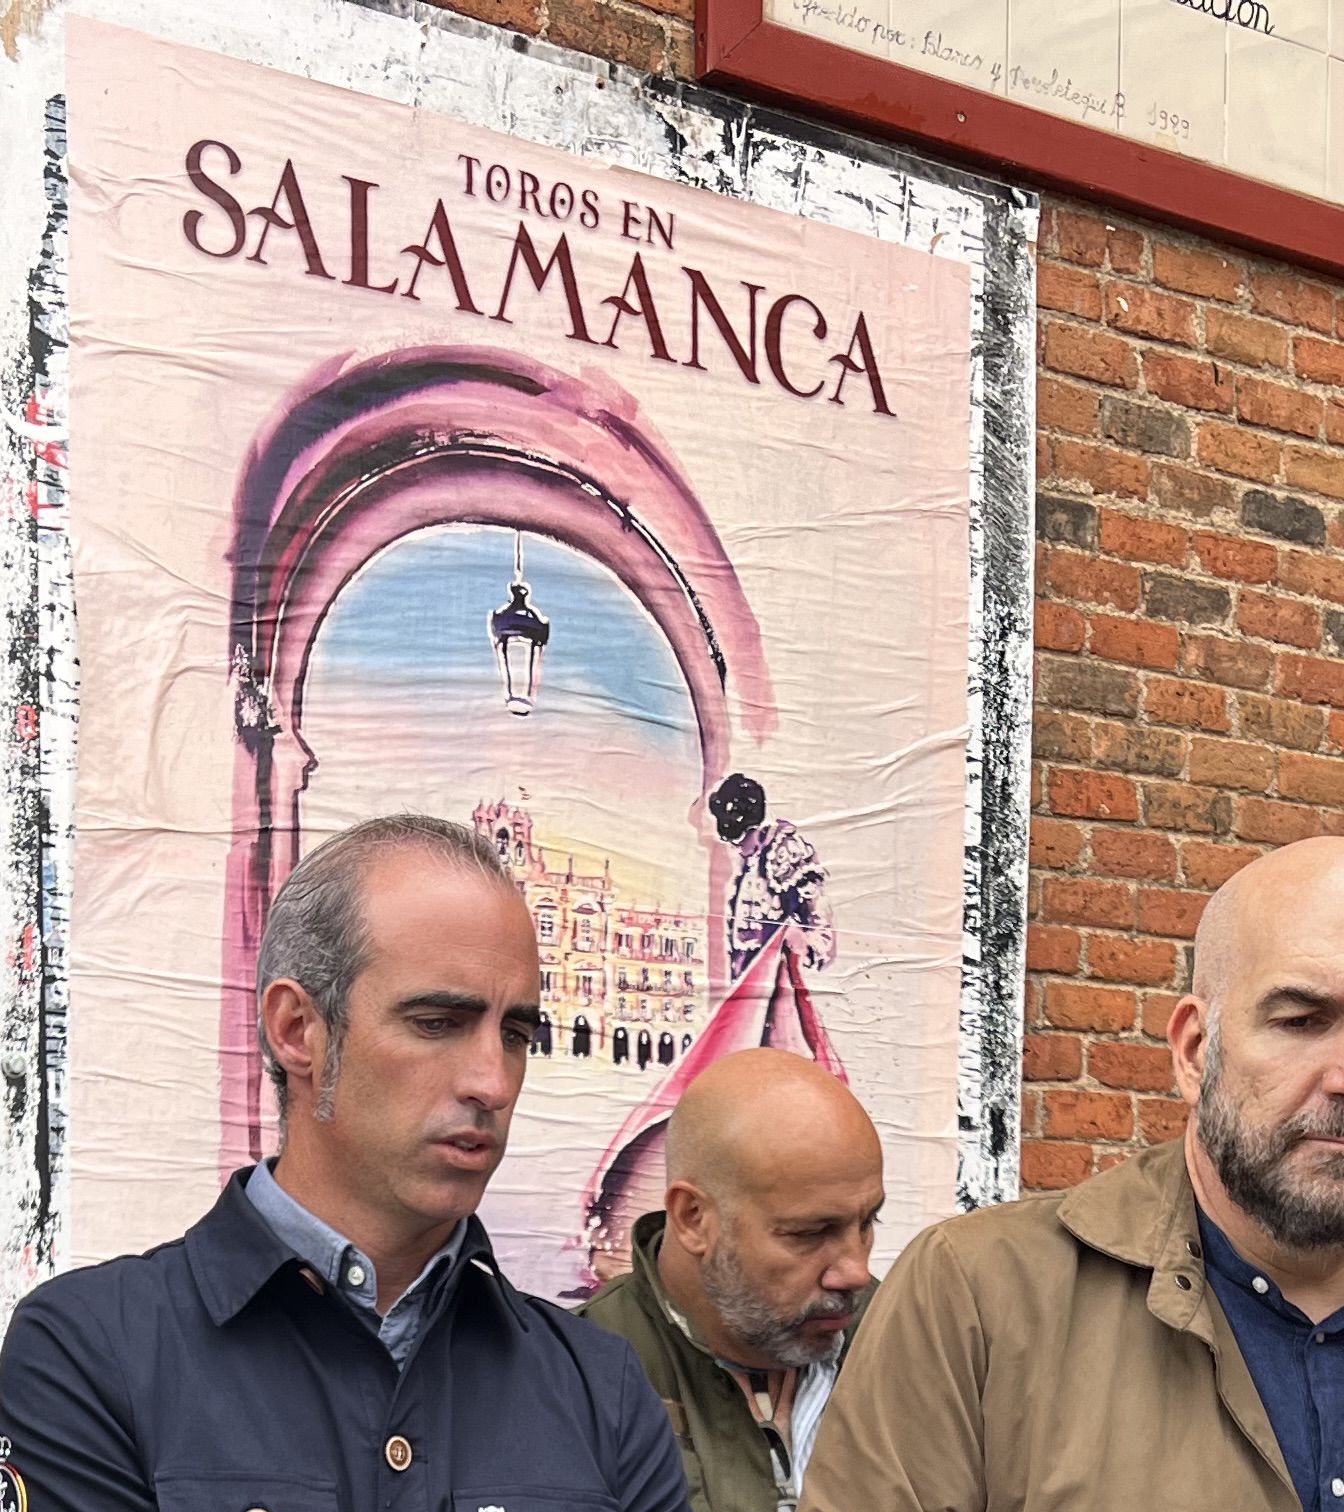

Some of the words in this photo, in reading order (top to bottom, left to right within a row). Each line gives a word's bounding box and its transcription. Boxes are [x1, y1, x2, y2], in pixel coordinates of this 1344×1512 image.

[182, 139, 897, 418] SALAMANCA
[457, 154, 600, 229] TOROS
[621, 200, 675, 250] EN
